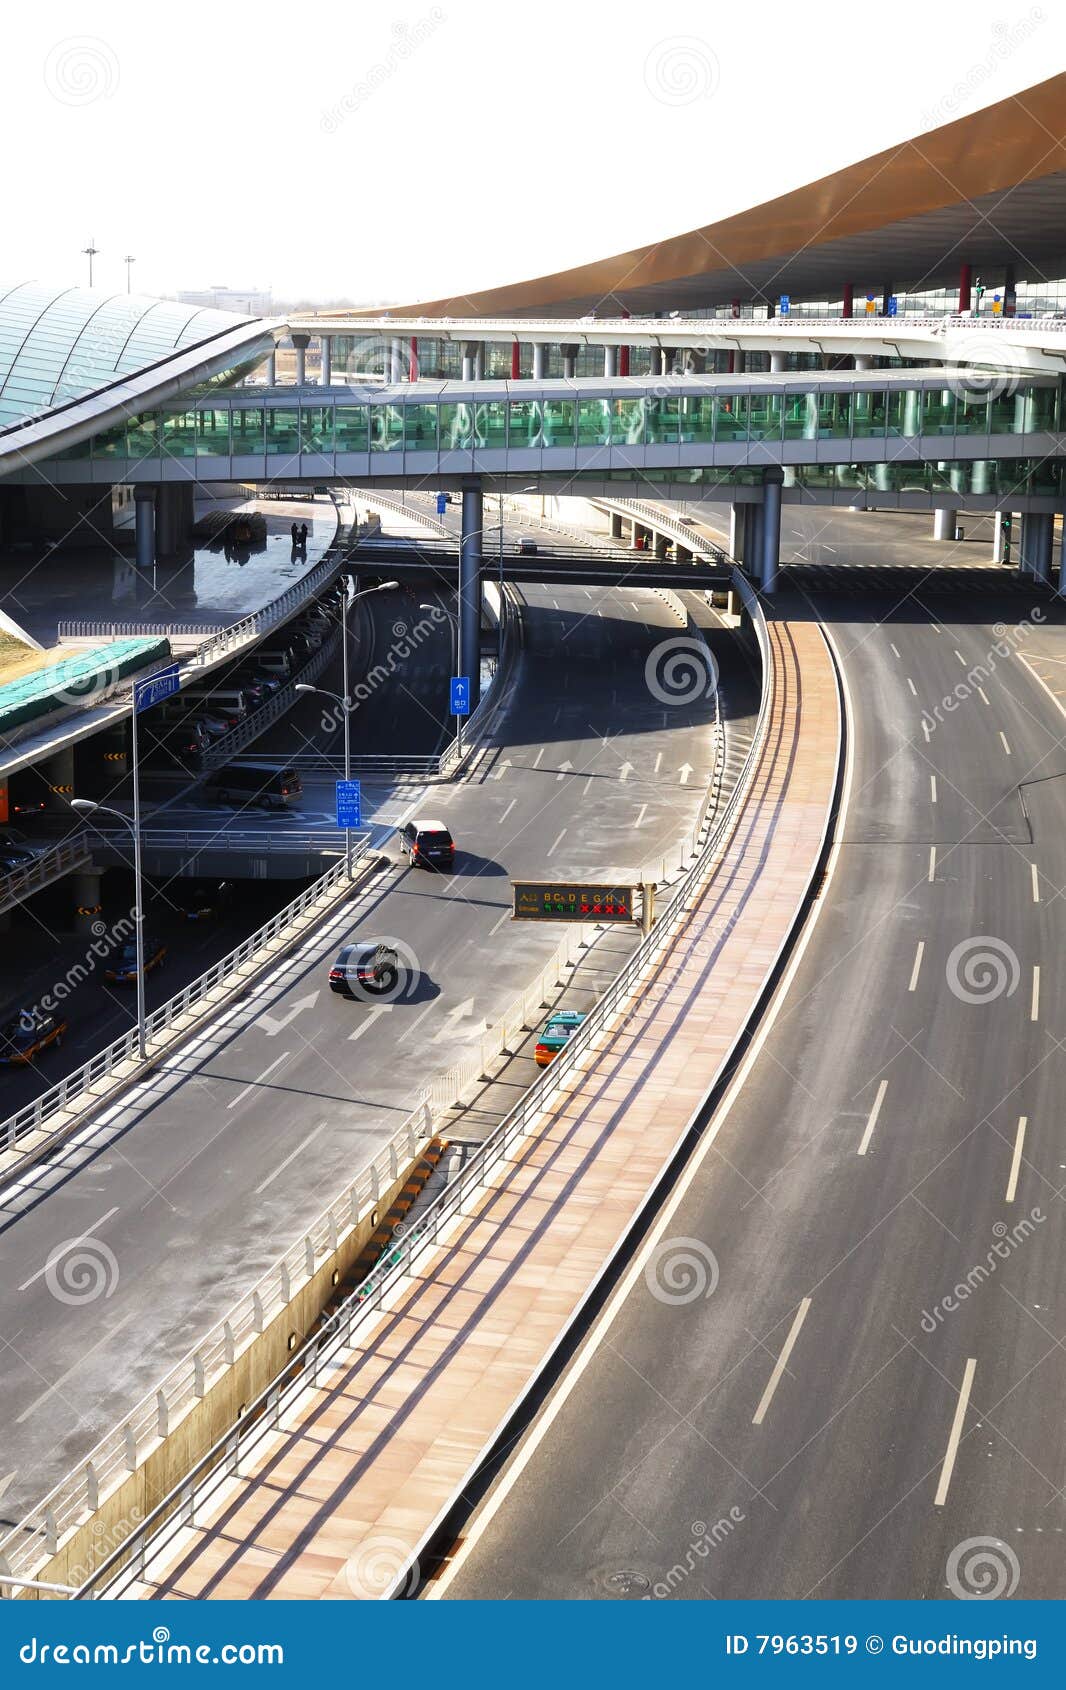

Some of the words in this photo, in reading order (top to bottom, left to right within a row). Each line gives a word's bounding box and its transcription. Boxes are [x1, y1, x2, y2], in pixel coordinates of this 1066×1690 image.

[581, 894, 588, 903] E
[593, 894, 601, 903] G
[606, 894, 613, 903] H
